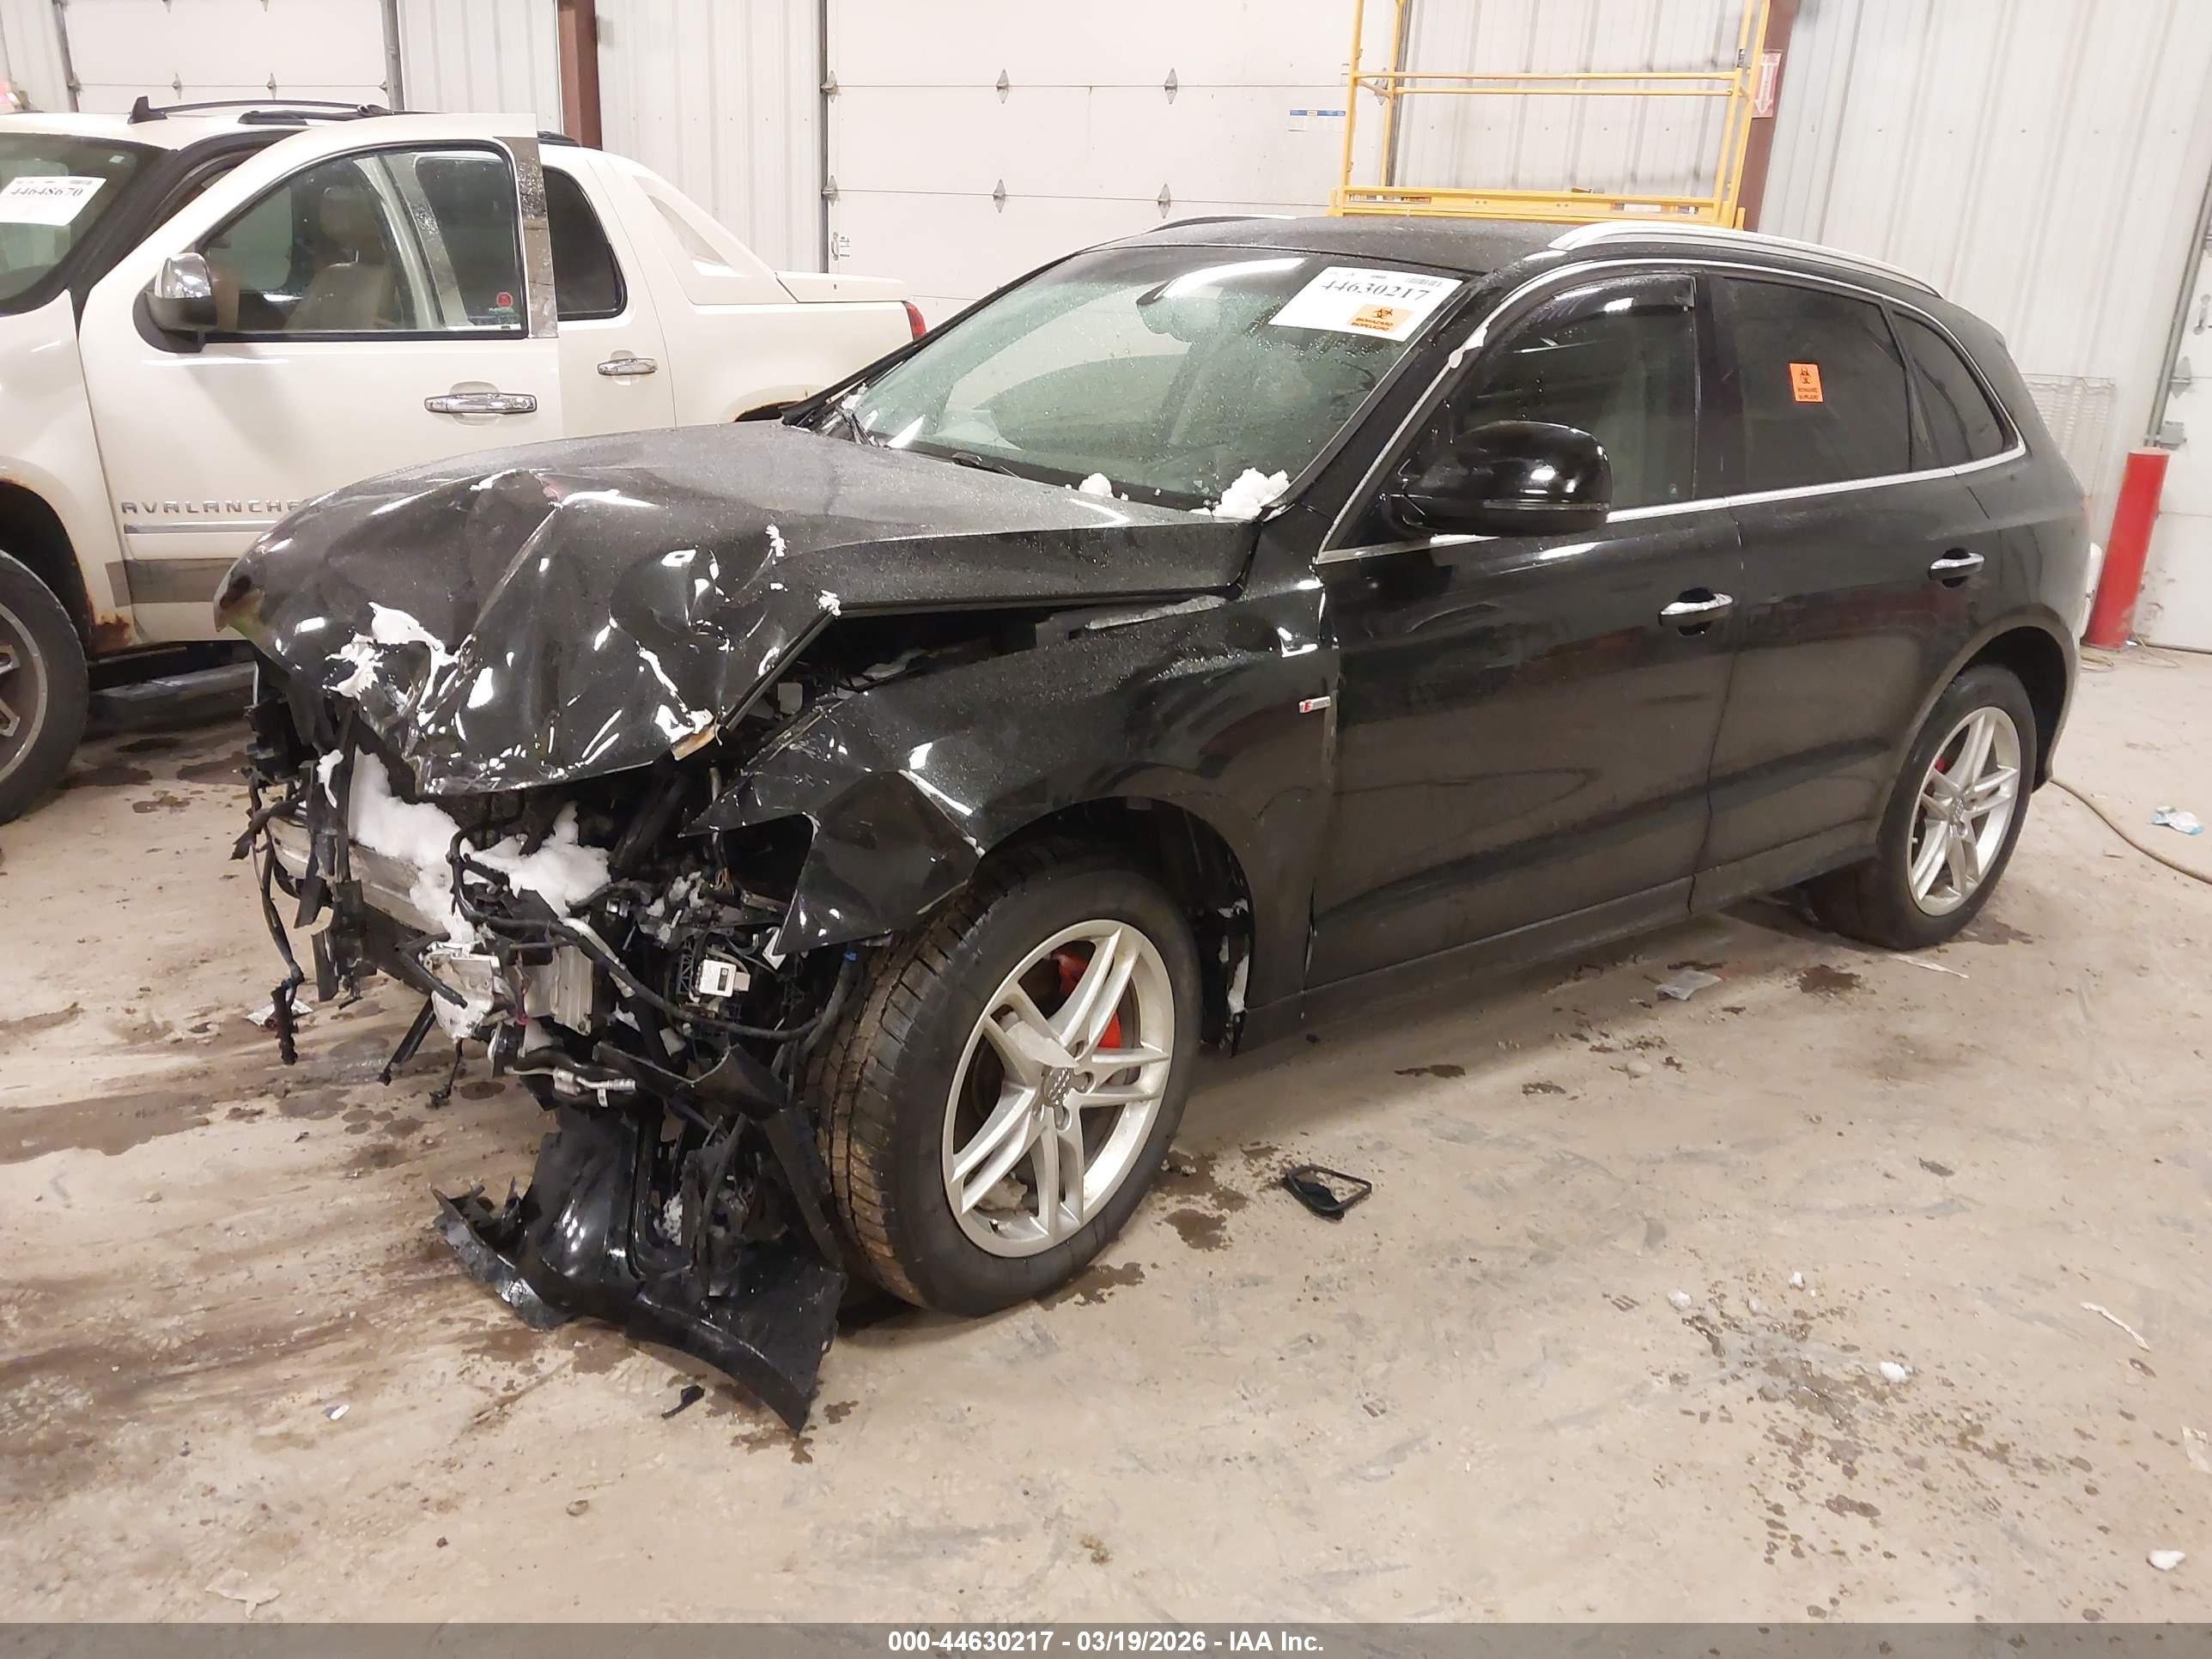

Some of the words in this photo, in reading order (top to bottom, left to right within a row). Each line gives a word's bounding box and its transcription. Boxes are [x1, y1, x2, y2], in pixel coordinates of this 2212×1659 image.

[10, 186, 84, 198] 44648670
[1321, 280, 1431, 301] 44630217
[121, 500, 301, 514] AVALANCHE
